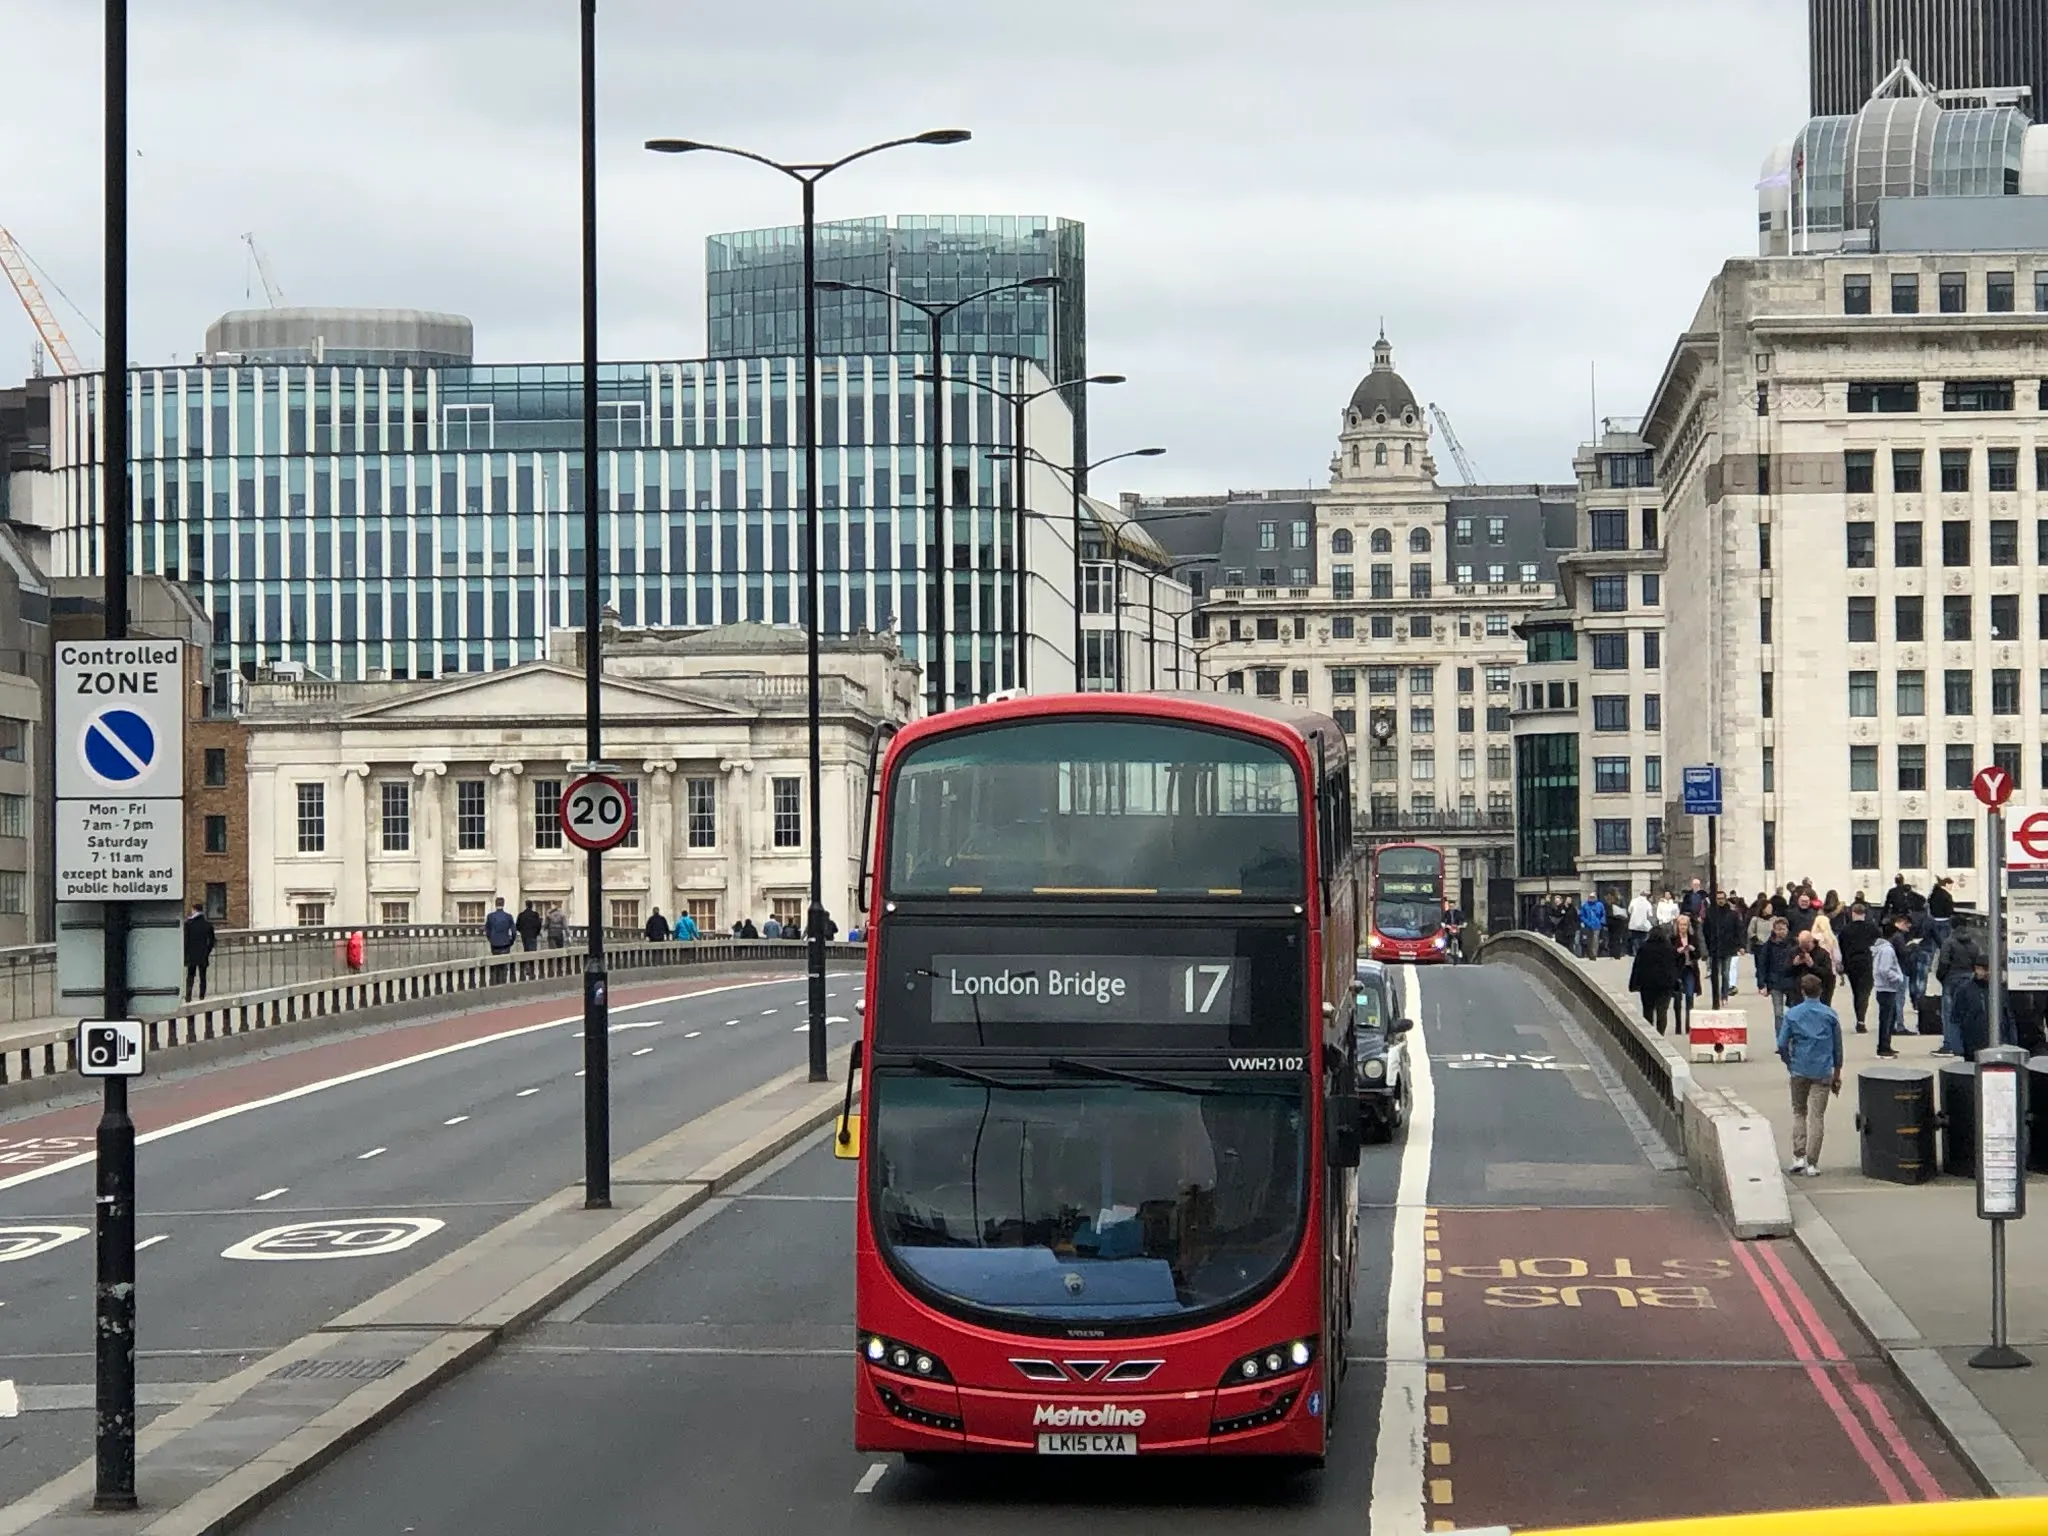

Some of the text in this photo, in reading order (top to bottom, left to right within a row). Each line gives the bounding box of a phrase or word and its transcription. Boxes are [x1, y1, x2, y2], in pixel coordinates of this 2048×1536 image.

[61, 646, 178, 665] Controlled
[77, 671, 159, 694] ZONE
[1982, 773, 2005, 801] Y
[89, 804, 118, 815] Mon
[128, 803, 147, 815] Fri
[572, 795, 622, 824] 20
[87, 836, 149, 849] Saturday
[91, 852, 99, 863] 7
[109, 852, 121, 863] 11
[123, 854, 144, 863] am
[61, 867, 174, 881] except bank and
[67, 882, 169, 896] public holidays
[951, 964, 1231, 1013] London Bridge 17
[1228, 1057, 1304, 1071] VWH2102
[259, 1228, 406, 1248] 20
[1447, 1257, 1735, 1280] STOP
[1483, 1285, 1717, 1309] BUS
[1032, 1403, 1147, 1427] Metroline
[1048, 1435, 1126, 1452] LK15 CXA
